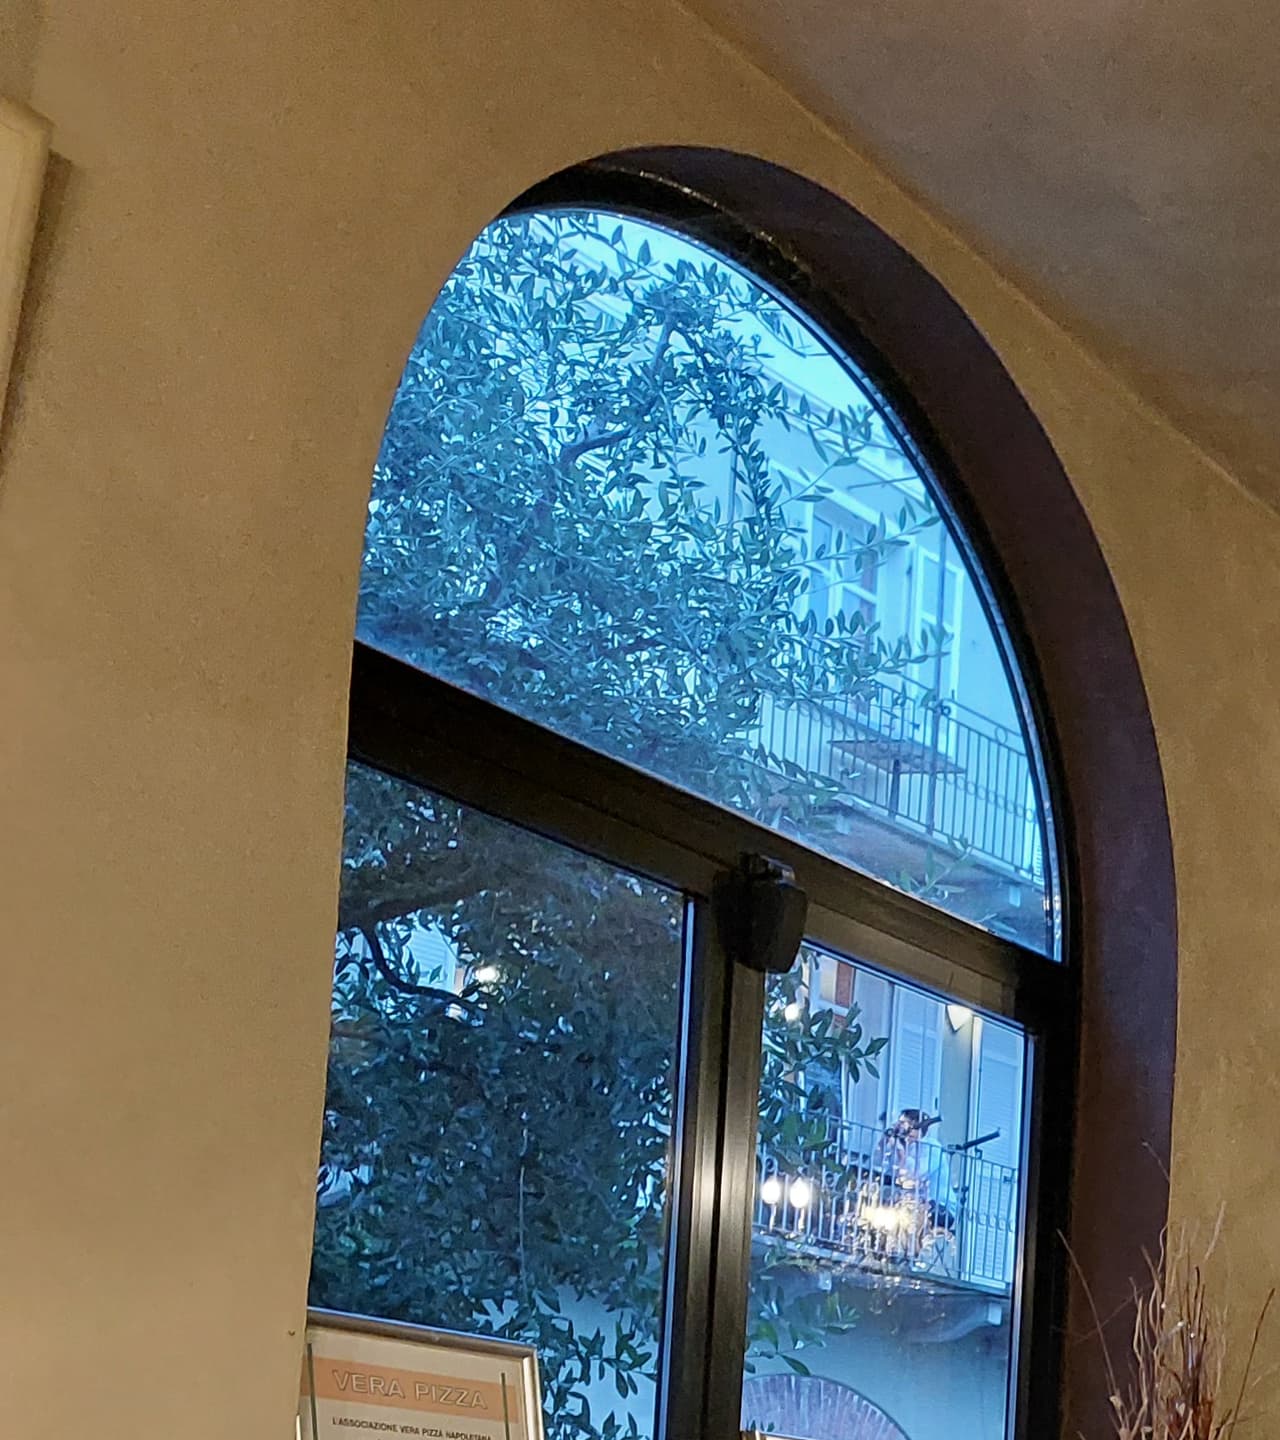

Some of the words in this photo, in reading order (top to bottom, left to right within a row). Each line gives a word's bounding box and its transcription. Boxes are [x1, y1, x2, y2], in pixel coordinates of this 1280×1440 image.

[332, 1369, 406, 1399] VERA
[415, 1383, 489, 1410] PIZZA
[400, 1425, 420, 1435] VERA
[422, 1428, 443, 1438] PIZZA
